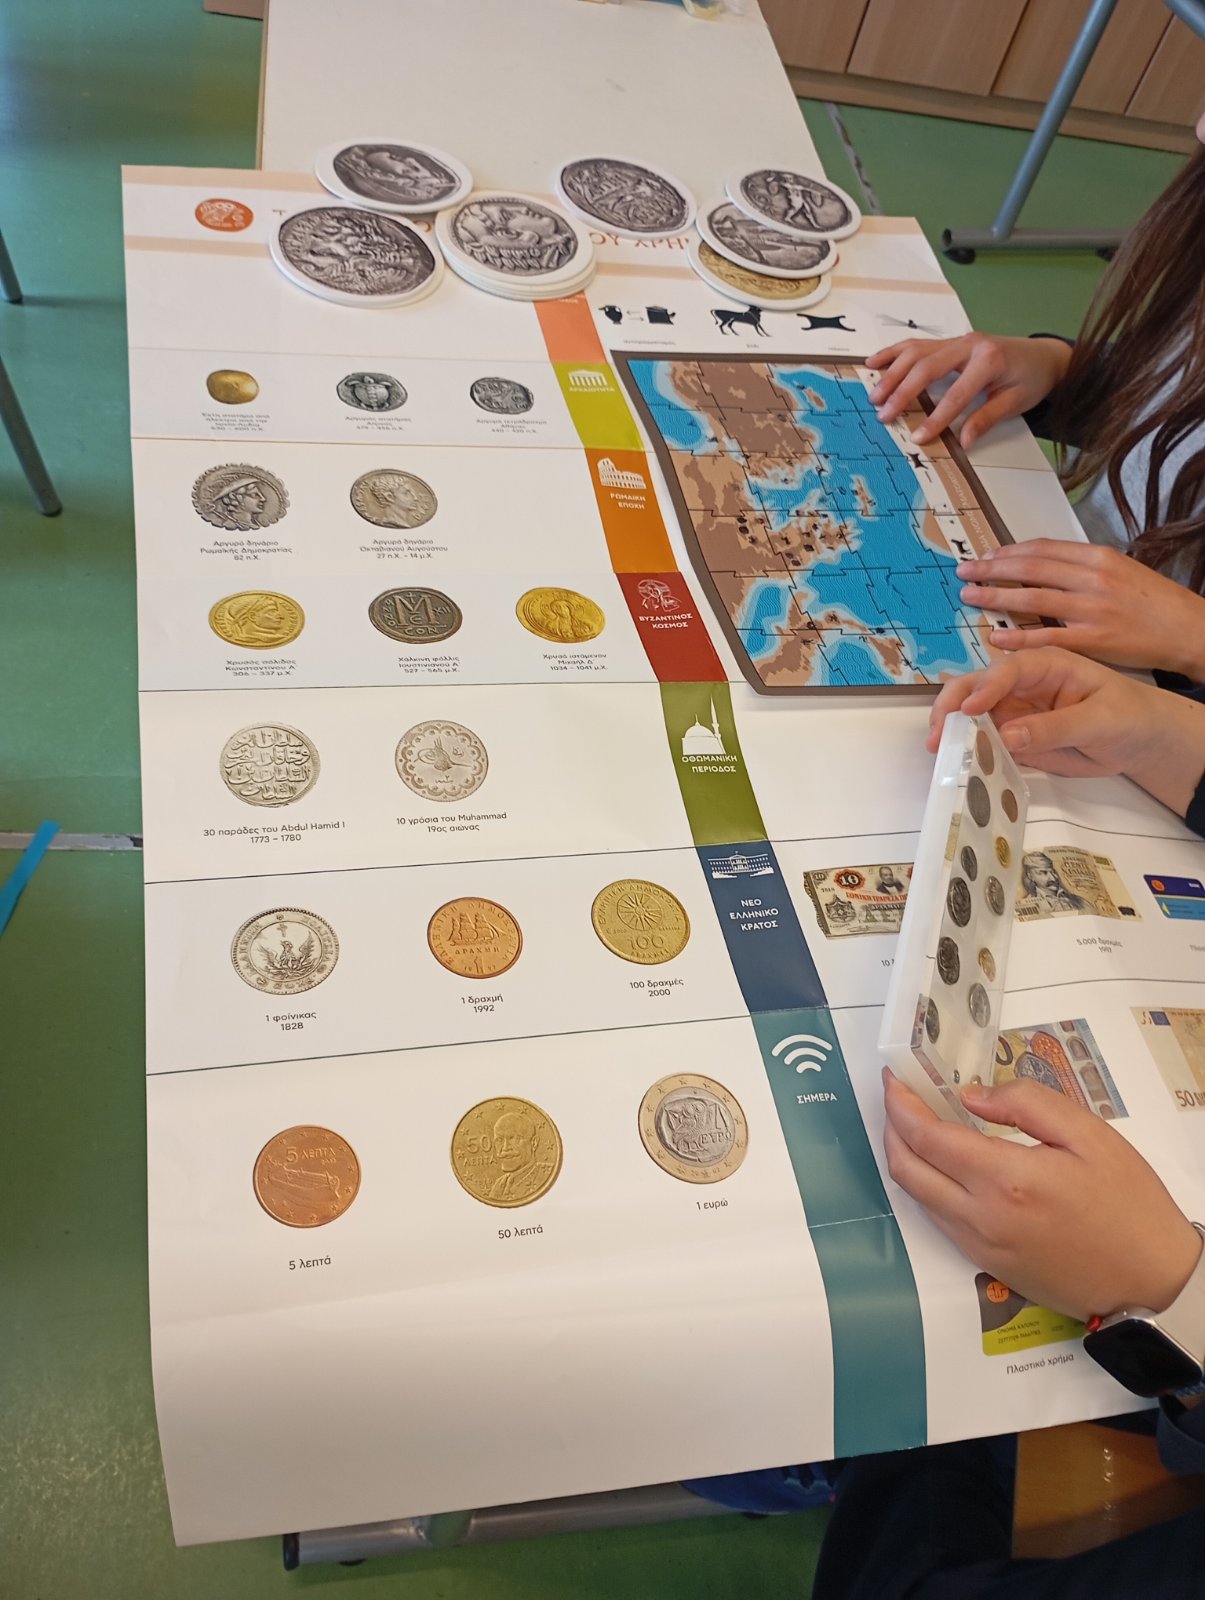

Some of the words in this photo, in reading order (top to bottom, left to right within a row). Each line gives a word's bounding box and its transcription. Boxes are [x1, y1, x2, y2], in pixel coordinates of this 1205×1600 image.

[639, 613, 693, 622] ΒΥΖΑΝΤΙΝΟΣ
[682, 754, 738, 763] ΟΘΩΜΑΝΙΚΗ
[408, 816, 439, 825] γρόσια
[458, 812, 507, 821] Muhammad
[219, 827, 259, 837] παράδες
[281, 823, 308, 832] Abdul
[311, 822, 340, 830] Hamid
[450, 824, 480, 832] αιώνας
[840, 874, 859, 886] 10
[740, 898, 762, 908] ΝΕΟ
[730, 908, 779, 920] ΕΛΛΗΝΙΚΟ
[740, 920, 778, 931] ΚΡΑΤΟΣ
[647, 979, 684, 988] δραχμές
[468, 994, 503, 1004] δραχμή
[648, 989, 671, 997] 2000
[474, 1004, 495, 1013] 1992
[272, 1012, 317, 1022] φοίνικας
[281, 1022, 304, 1031] 1828
[797, 1092, 837, 1104] ΣΗΜΕΡΑ
[1175, 1090, 1195, 1107] 50
[467, 1134, 493, 1154] 50
[286, 1147, 298, 1164] 5
[302, 1147, 336, 1160] ΛΕΠΤΑ
[703, 1198, 728, 1210] ευρώ
[498, 1229, 511, 1239] 50
[514, 1224, 544, 1237] λεπτά
[289, 1260, 296, 1270] 5
[300, 1255, 331, 1269] λεπτά
[1006, 1359, 1046, 1374] Πλαστικό
[1048, 1353, 1074, 1365] χρήμα
